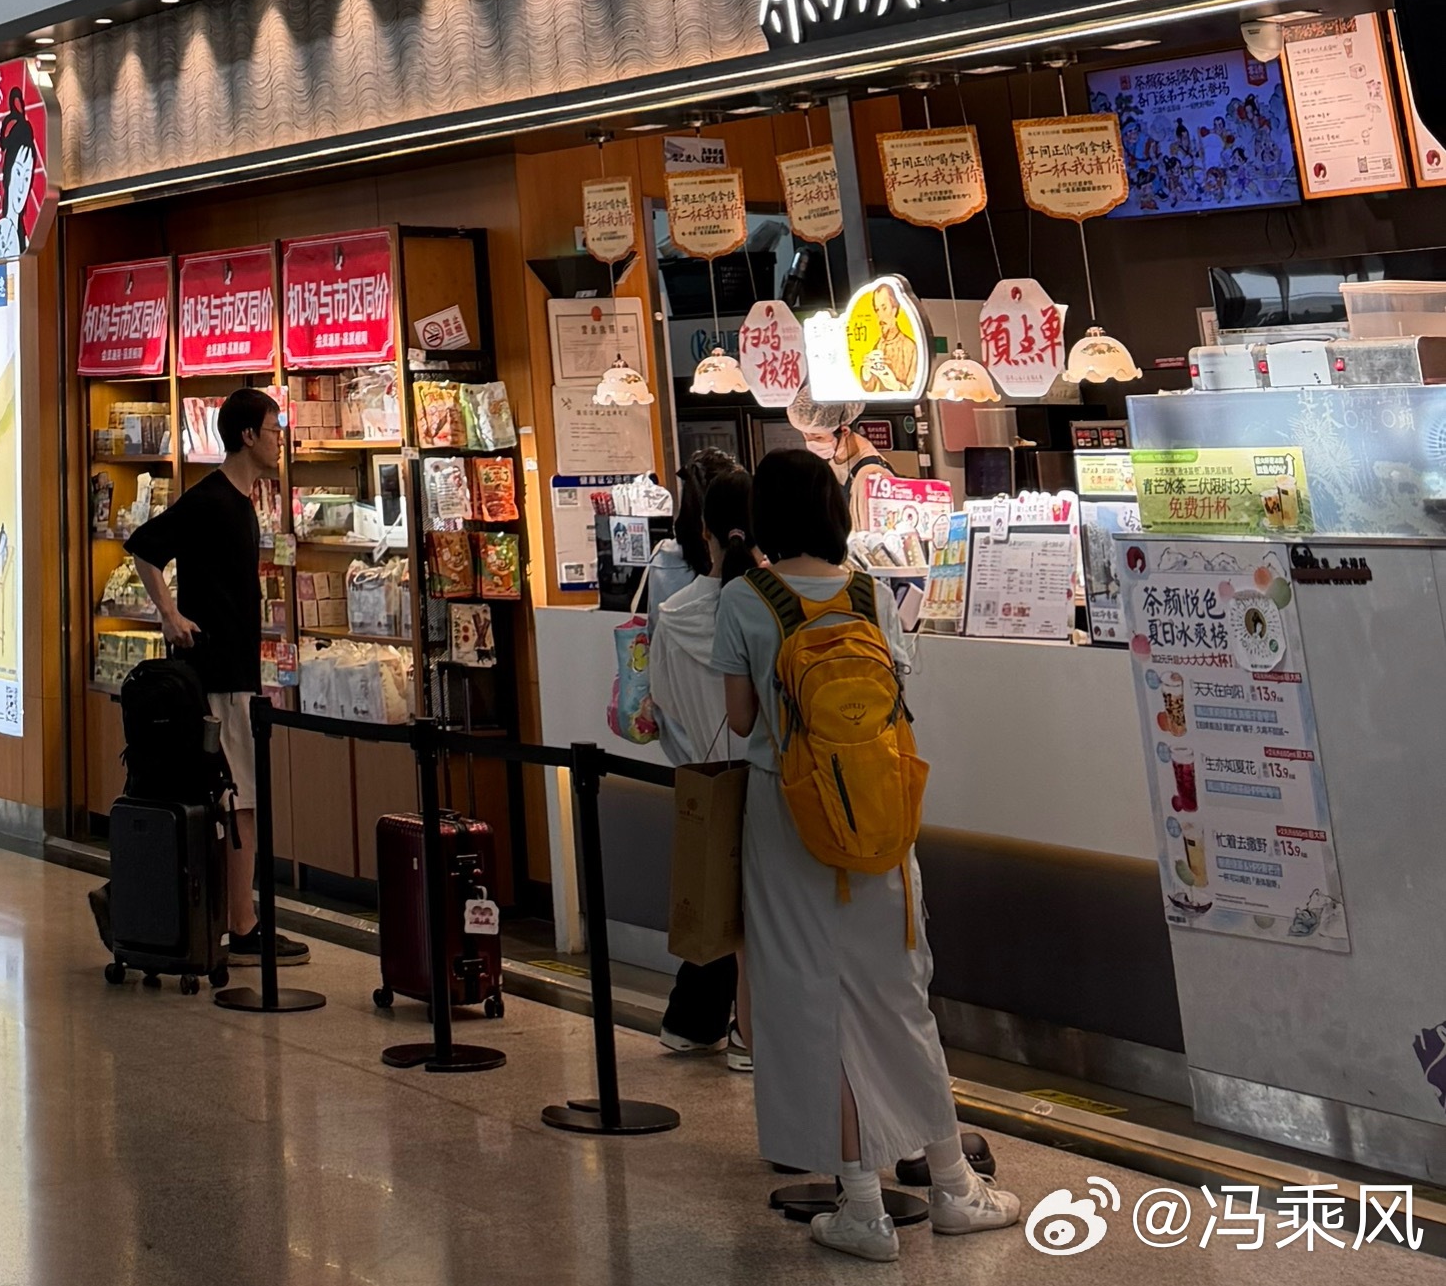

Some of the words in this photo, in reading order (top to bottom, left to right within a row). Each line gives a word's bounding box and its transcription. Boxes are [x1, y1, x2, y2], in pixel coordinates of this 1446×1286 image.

[1026, 140, 1116, 160] 早间正价喝拿铁
[886, 165, 983, 191] 第二杯我请你
[1021, 154, 1124, 182] 第二杯我请你
[182, 286, 273, 337] 机场与市区同价
[287, 272, 389, 327] 机场与市区同价
[84, 297, 166, 343] 机场与市区同价
[741, 319, 781, 354] 扫码
[755, 349, 802, 389] 核销
[1168, 496, 1231, 520] 免费升杯
[1143, 586, 1226, 620] 茶颜悦色
[1148, 619, 1229, 650] 夏日冰爽榜
